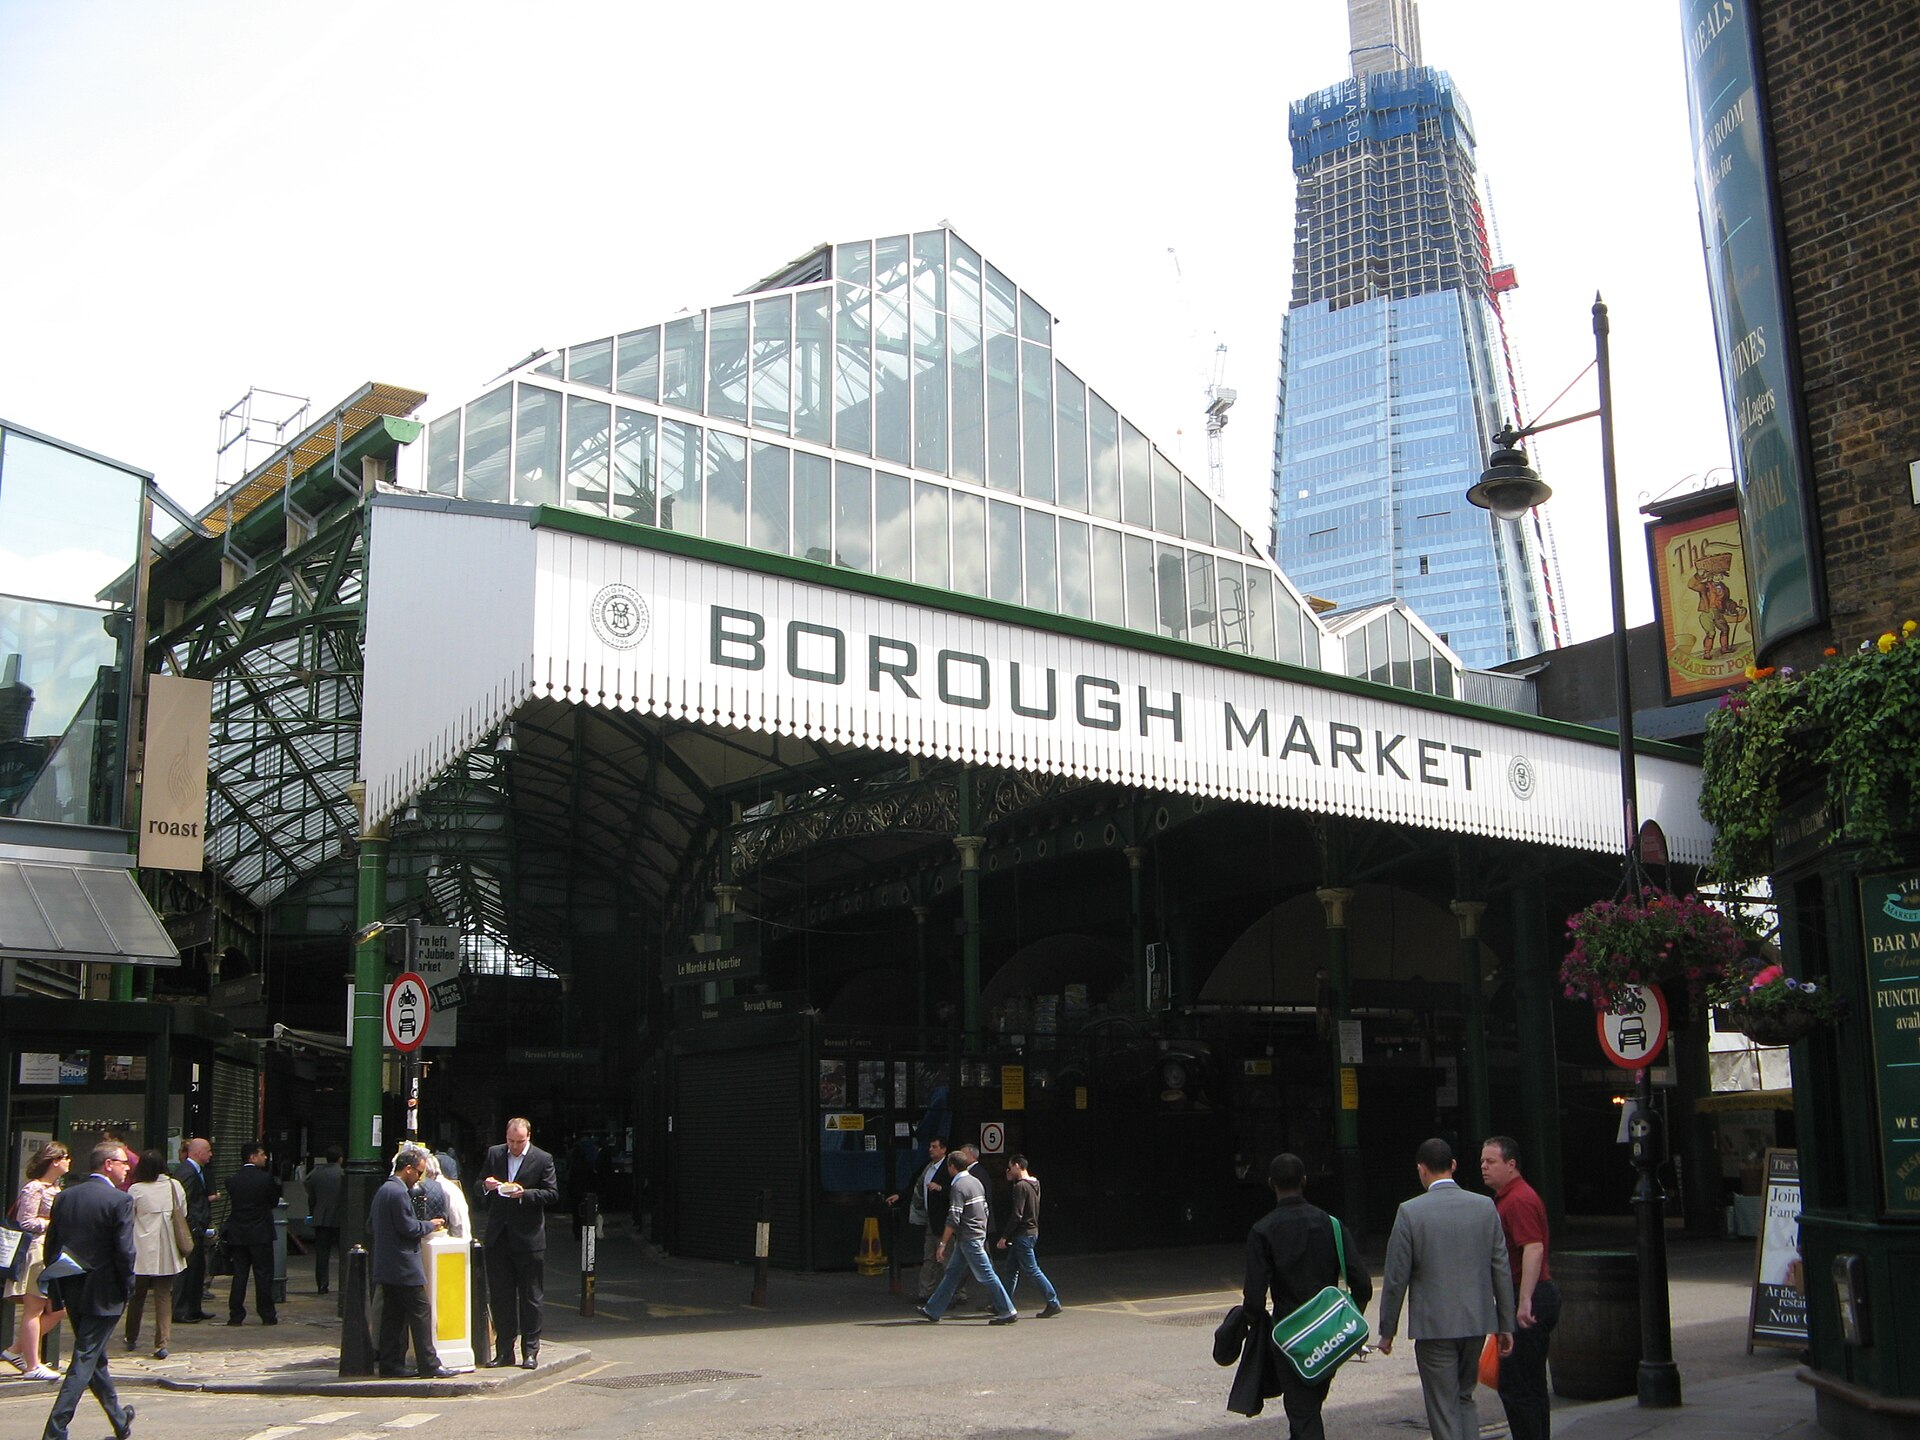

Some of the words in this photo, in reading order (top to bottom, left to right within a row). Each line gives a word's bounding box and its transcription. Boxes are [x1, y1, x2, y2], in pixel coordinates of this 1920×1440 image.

[1343, 76, 1360, 143] SHARD
[1714, 99, 1744, 147] ROOM
[1720, 154, 1732, 179] for
[1745, 388, 1776, 426] Lagers
[1674, 537, 1711, 576] The
[1674, 652, 1725, 677] MARKET
[709, 604, 1182, 742] BOROUGH
[1224, 701, 1482, 792] MARKET
[148, 820, 199, 838] roast
[432, 935, 447, 947] left
[1872, 934, 1906, 953] BAR
[425, 947, 455, 960] Jubilee
[418, 962, 441, 972] arket
[437, 982, 458, 997] More
[440, 991, 461, 1007] stalls
[60, 1067, 88, 1077] SHOP
[989, 1132, 996, 1144] 5
[1773, 1159, 1791, 1171] The
[1770, 1187, 1800, 1203] Join
[1765, 1286, 1778, 1298] At
[1780, 1286, 1798, 1299] the
[1769, 1308, 1800, 1324] Now
[1303, 1331, 1347, 1369] adidas
